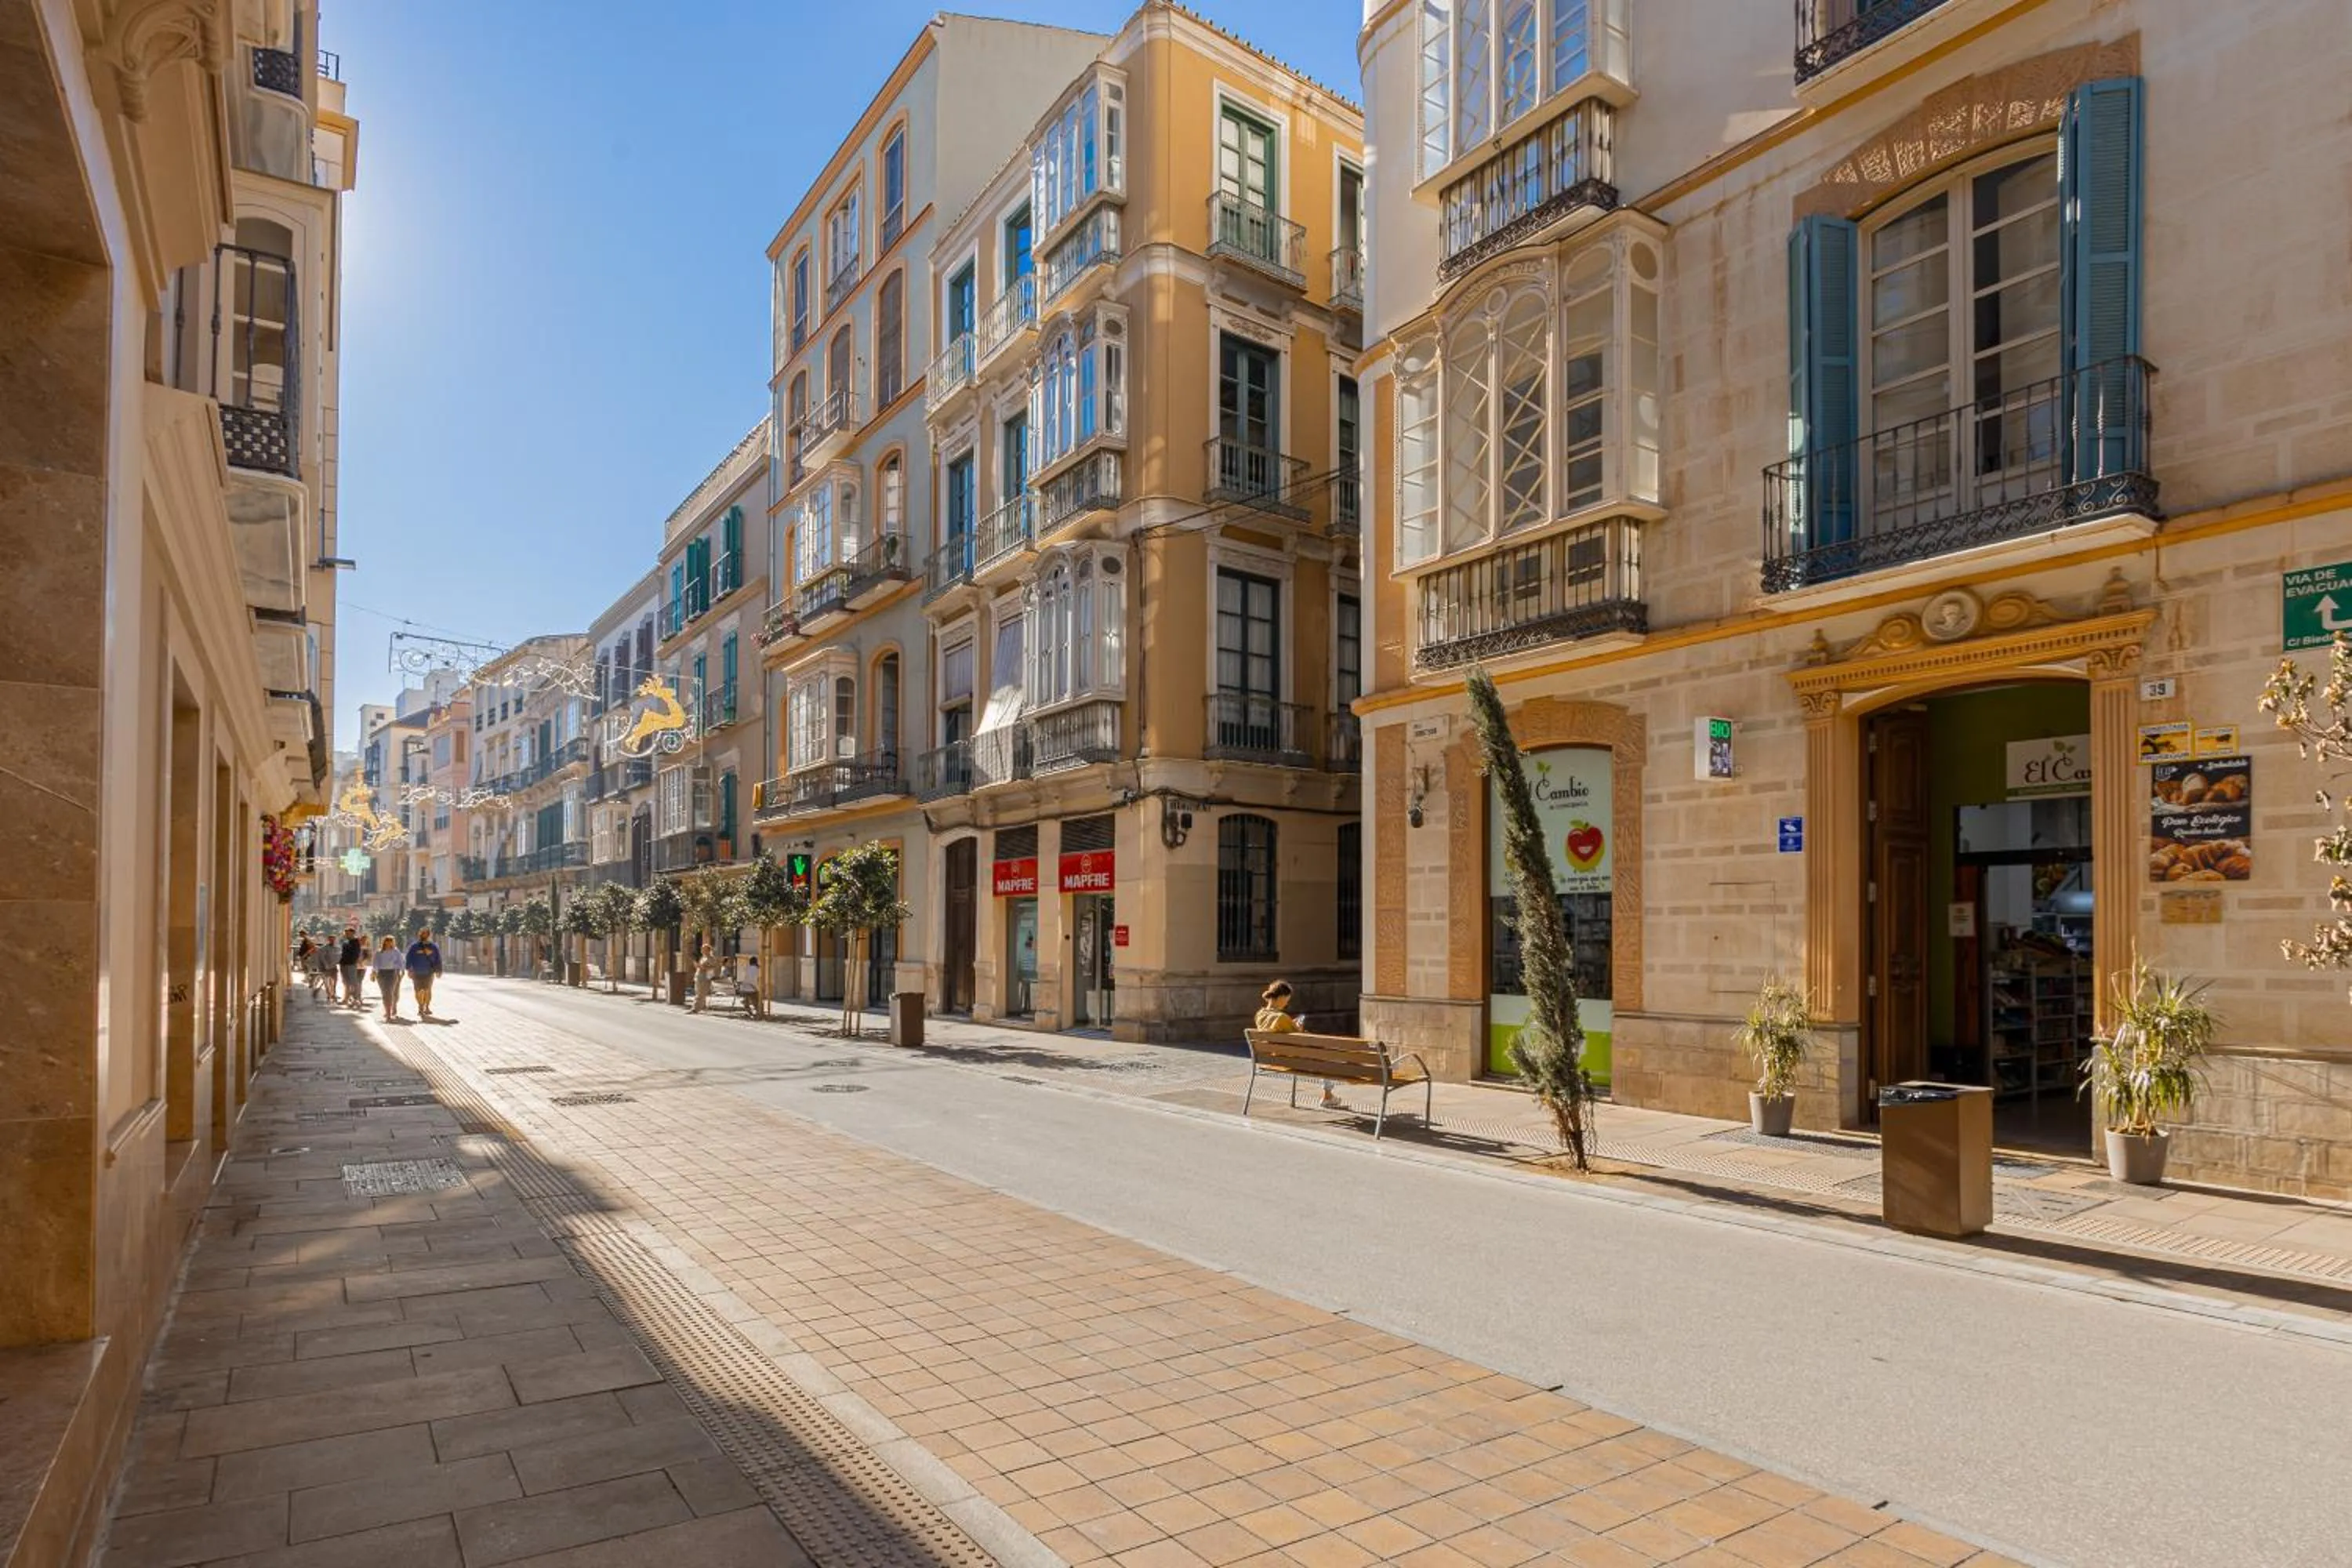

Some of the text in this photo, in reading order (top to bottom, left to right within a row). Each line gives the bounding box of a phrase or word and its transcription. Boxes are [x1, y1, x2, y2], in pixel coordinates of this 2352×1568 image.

[2286, 568, 2336, 586] VIA DE
[1710, 720, 1730, 739] BIO
[2024, 757, 2048, 782] El
[1536, 774, 1589, 800] Cambio
[997, 878, 1035, 891] MAPFRE
[1064, 873, 1110, 888] MAPFRE
